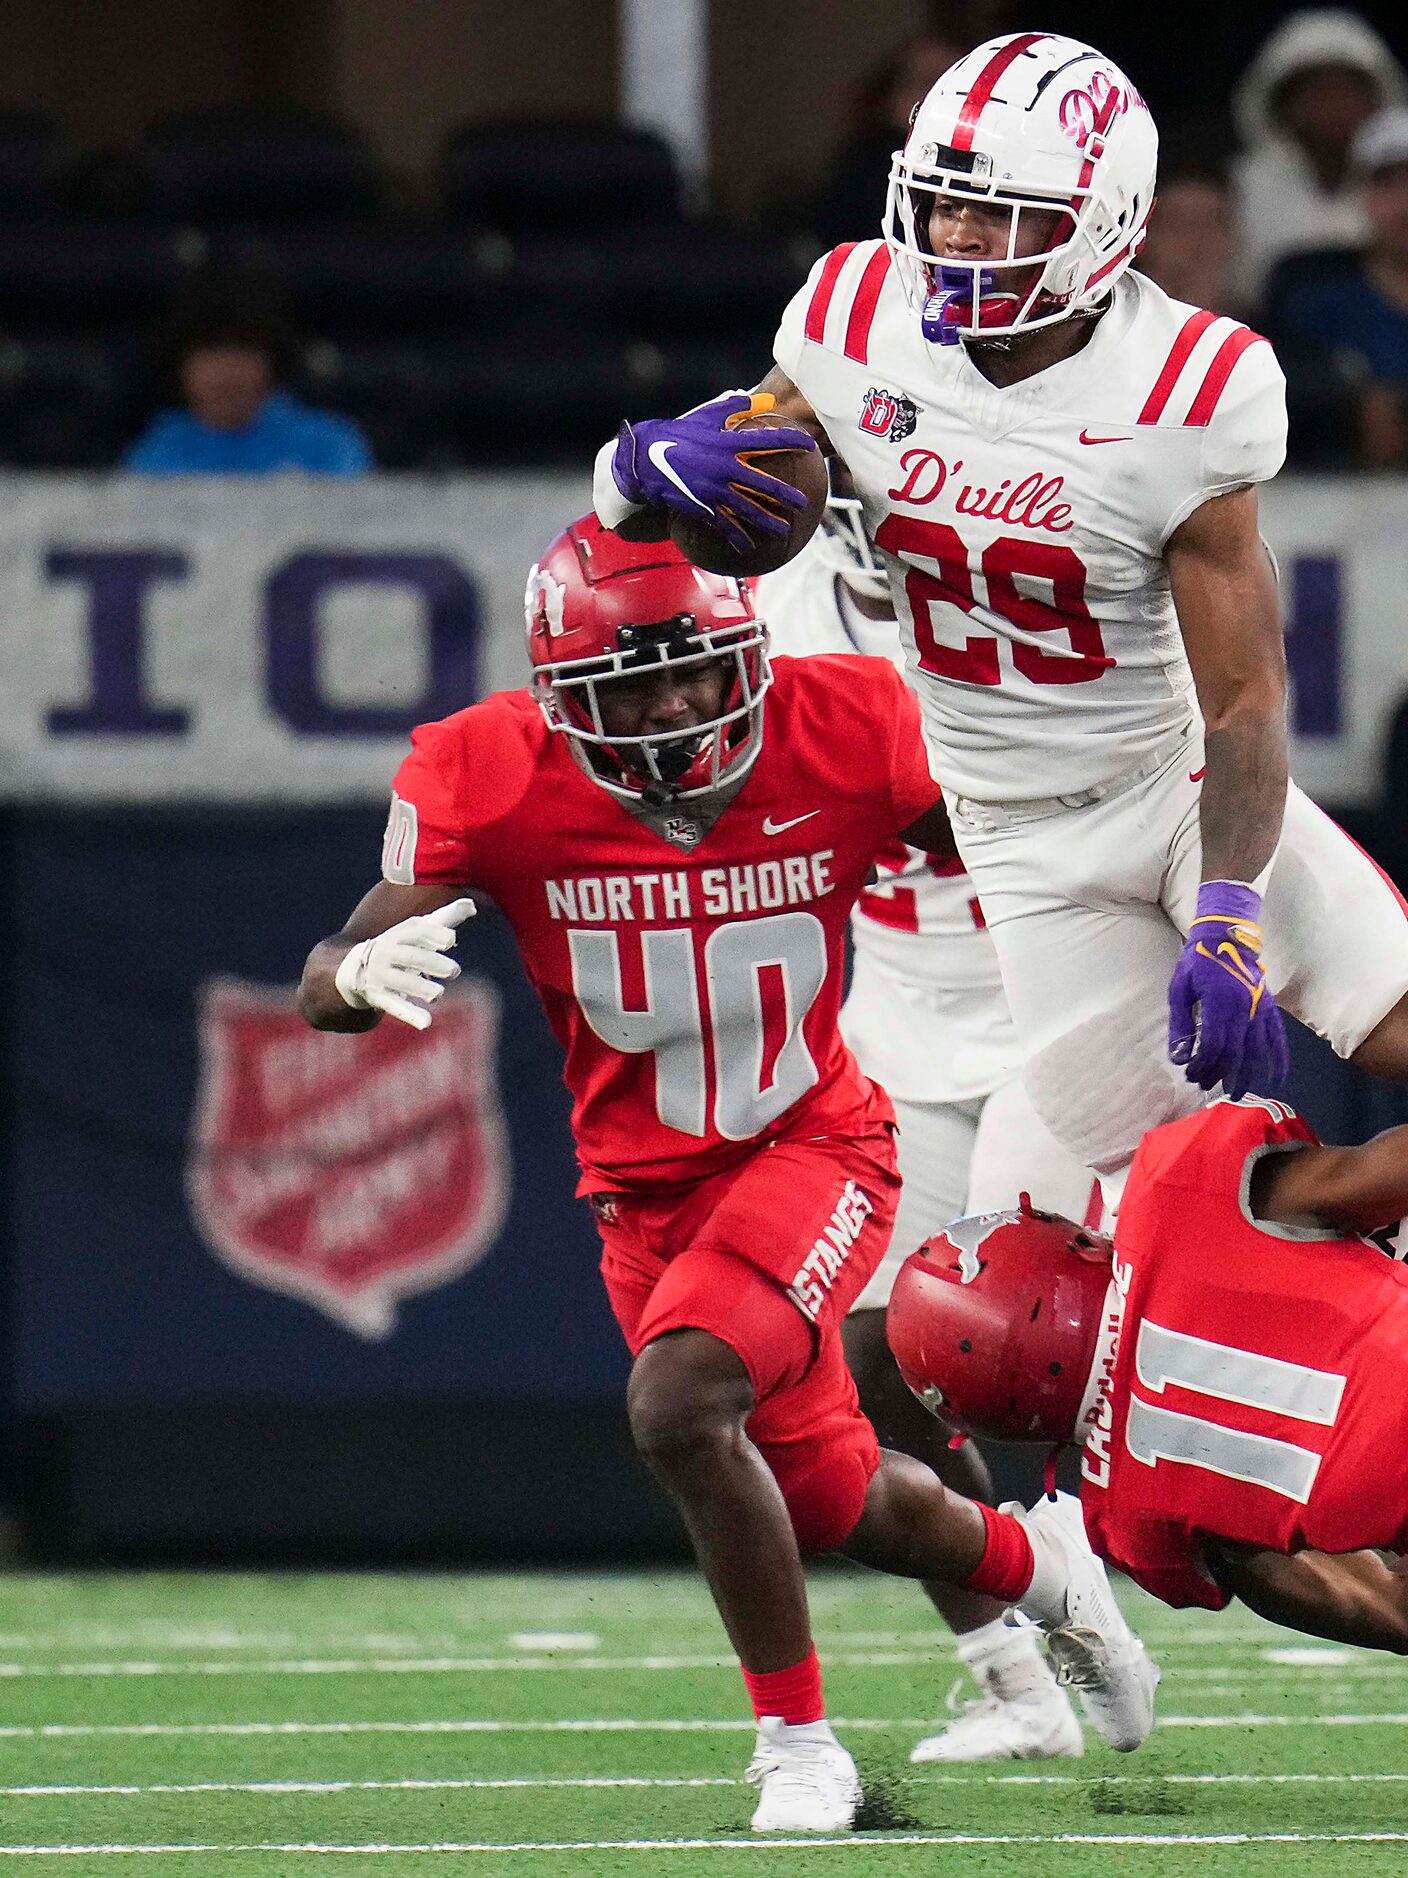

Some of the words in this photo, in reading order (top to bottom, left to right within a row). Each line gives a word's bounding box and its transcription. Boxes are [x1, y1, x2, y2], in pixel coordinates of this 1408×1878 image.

[888, 448, 1075, 533] D'ville
[874, 511, 1117, 686] 29
[545, 871, 692, 922] NORTH
[701, 848, 837, 916] SHORE
[566, 911, 828, 1142] 40
[1125, 1316, 1348, 1505] 11
